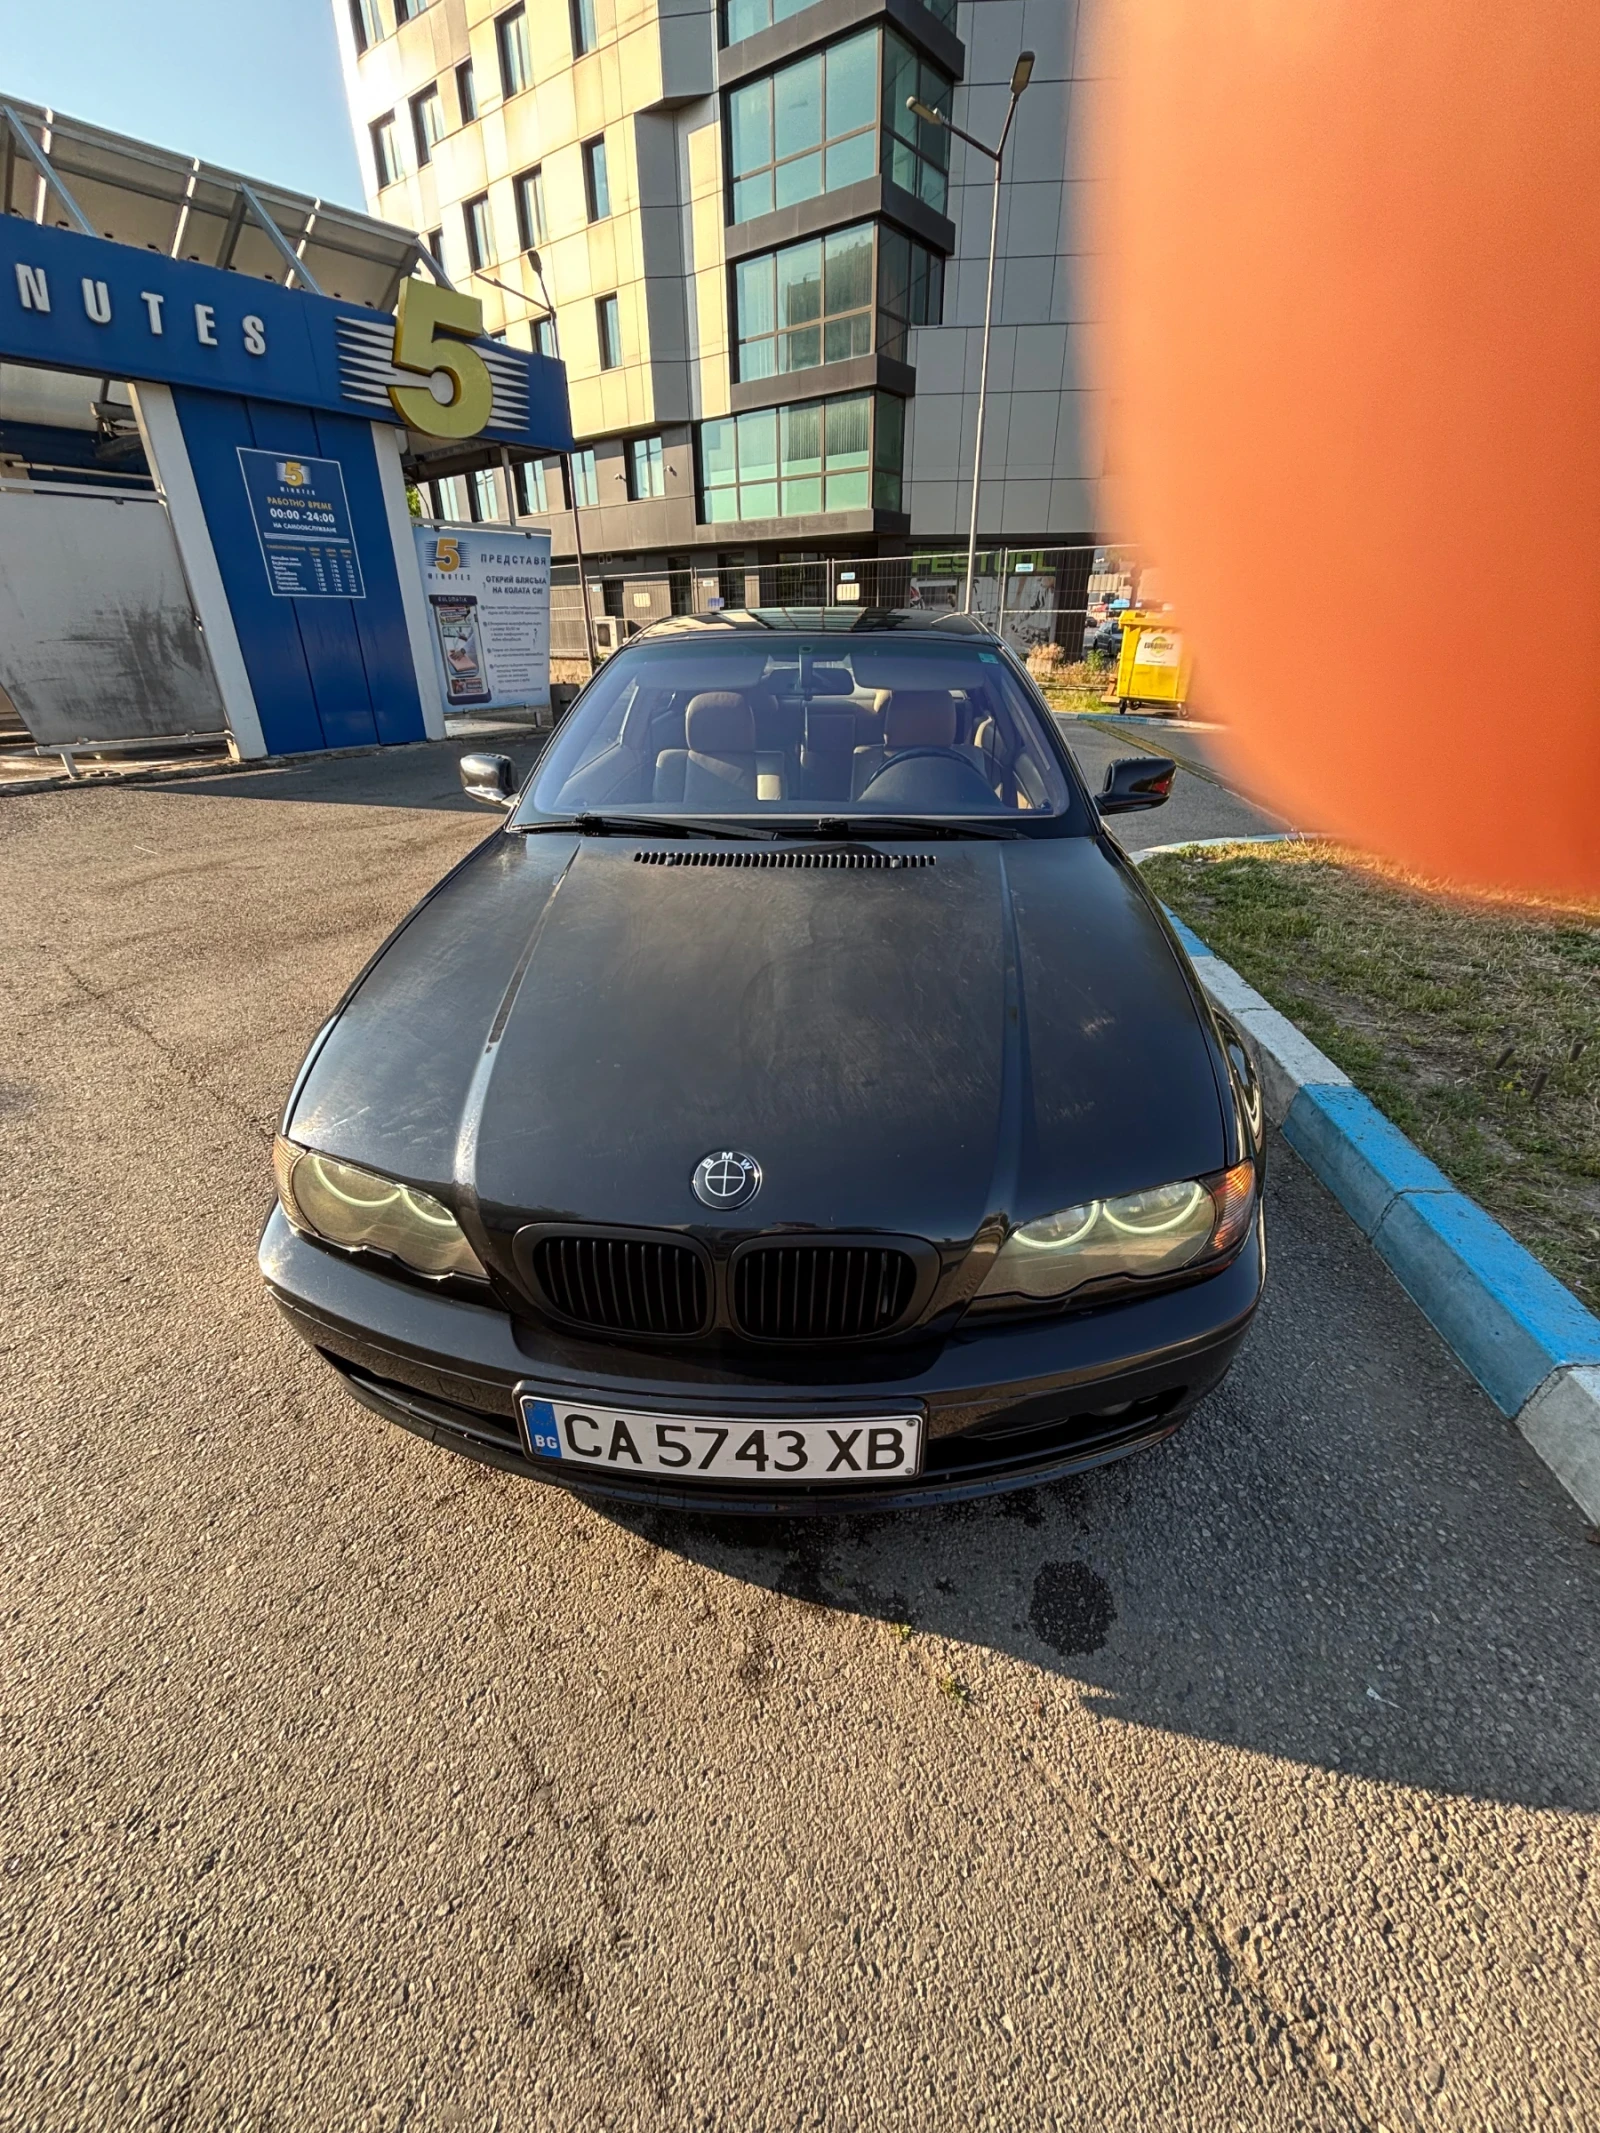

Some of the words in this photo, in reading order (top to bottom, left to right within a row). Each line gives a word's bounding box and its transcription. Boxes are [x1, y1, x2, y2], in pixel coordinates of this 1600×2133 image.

[387, 277, 493, 440] 5
[284, 461, 303, 487] 5
[266, 496, 306, 508] РАБОТНО
[307, 500, 333, 510] ВРЕМЕ
[270, 508, 300, 520] 00:00
[435, 537, 460, 573] 5
[480, 553, 547, 566] ПРЕДСТАВЯ
[485, 575, 514, 584] ОТКРИЙ
[492, 586, 503, 594] НА
[504, 587, 531, 595] КОЛАТА
[701, 1151, 752, 1170] BMW
[534, 1435, 558, 1450] BG
[563, 1414, 642, 1465] CA
[655, 1424, 809, 1473] 5743
[826, 1427, 905, 1471] XB
